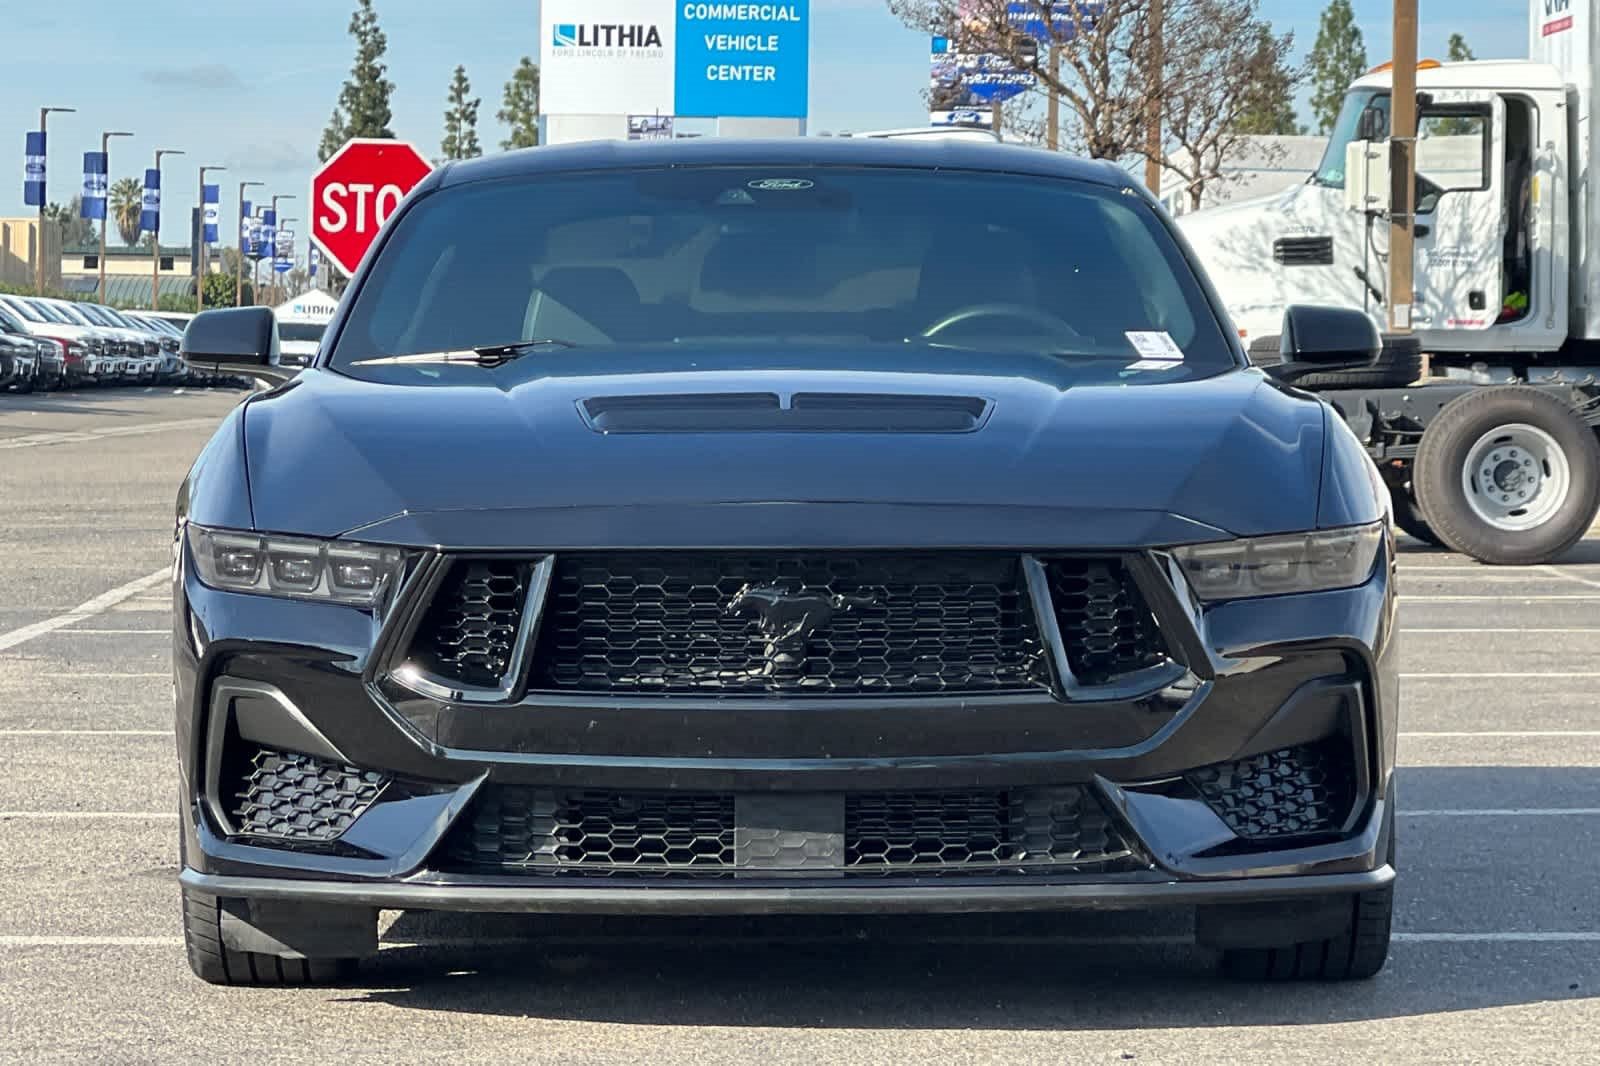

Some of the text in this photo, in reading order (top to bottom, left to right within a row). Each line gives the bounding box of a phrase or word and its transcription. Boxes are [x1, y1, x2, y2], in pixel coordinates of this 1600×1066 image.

[684, 3, 801, 21] COMMERCIAL
[578, 24, 662, 48] LITHIA
[704, 34, 779, 51] VEHICLE
[552, 49, 574, 57] FORD
[577, 49, 613, 57] LINCOLN
[630, 49, 663, 57] FRESNO
[706, 64, 776, 81] CENTER
[760, 180, 801, 189] Ford
[319, 182, 414, 233] STO
